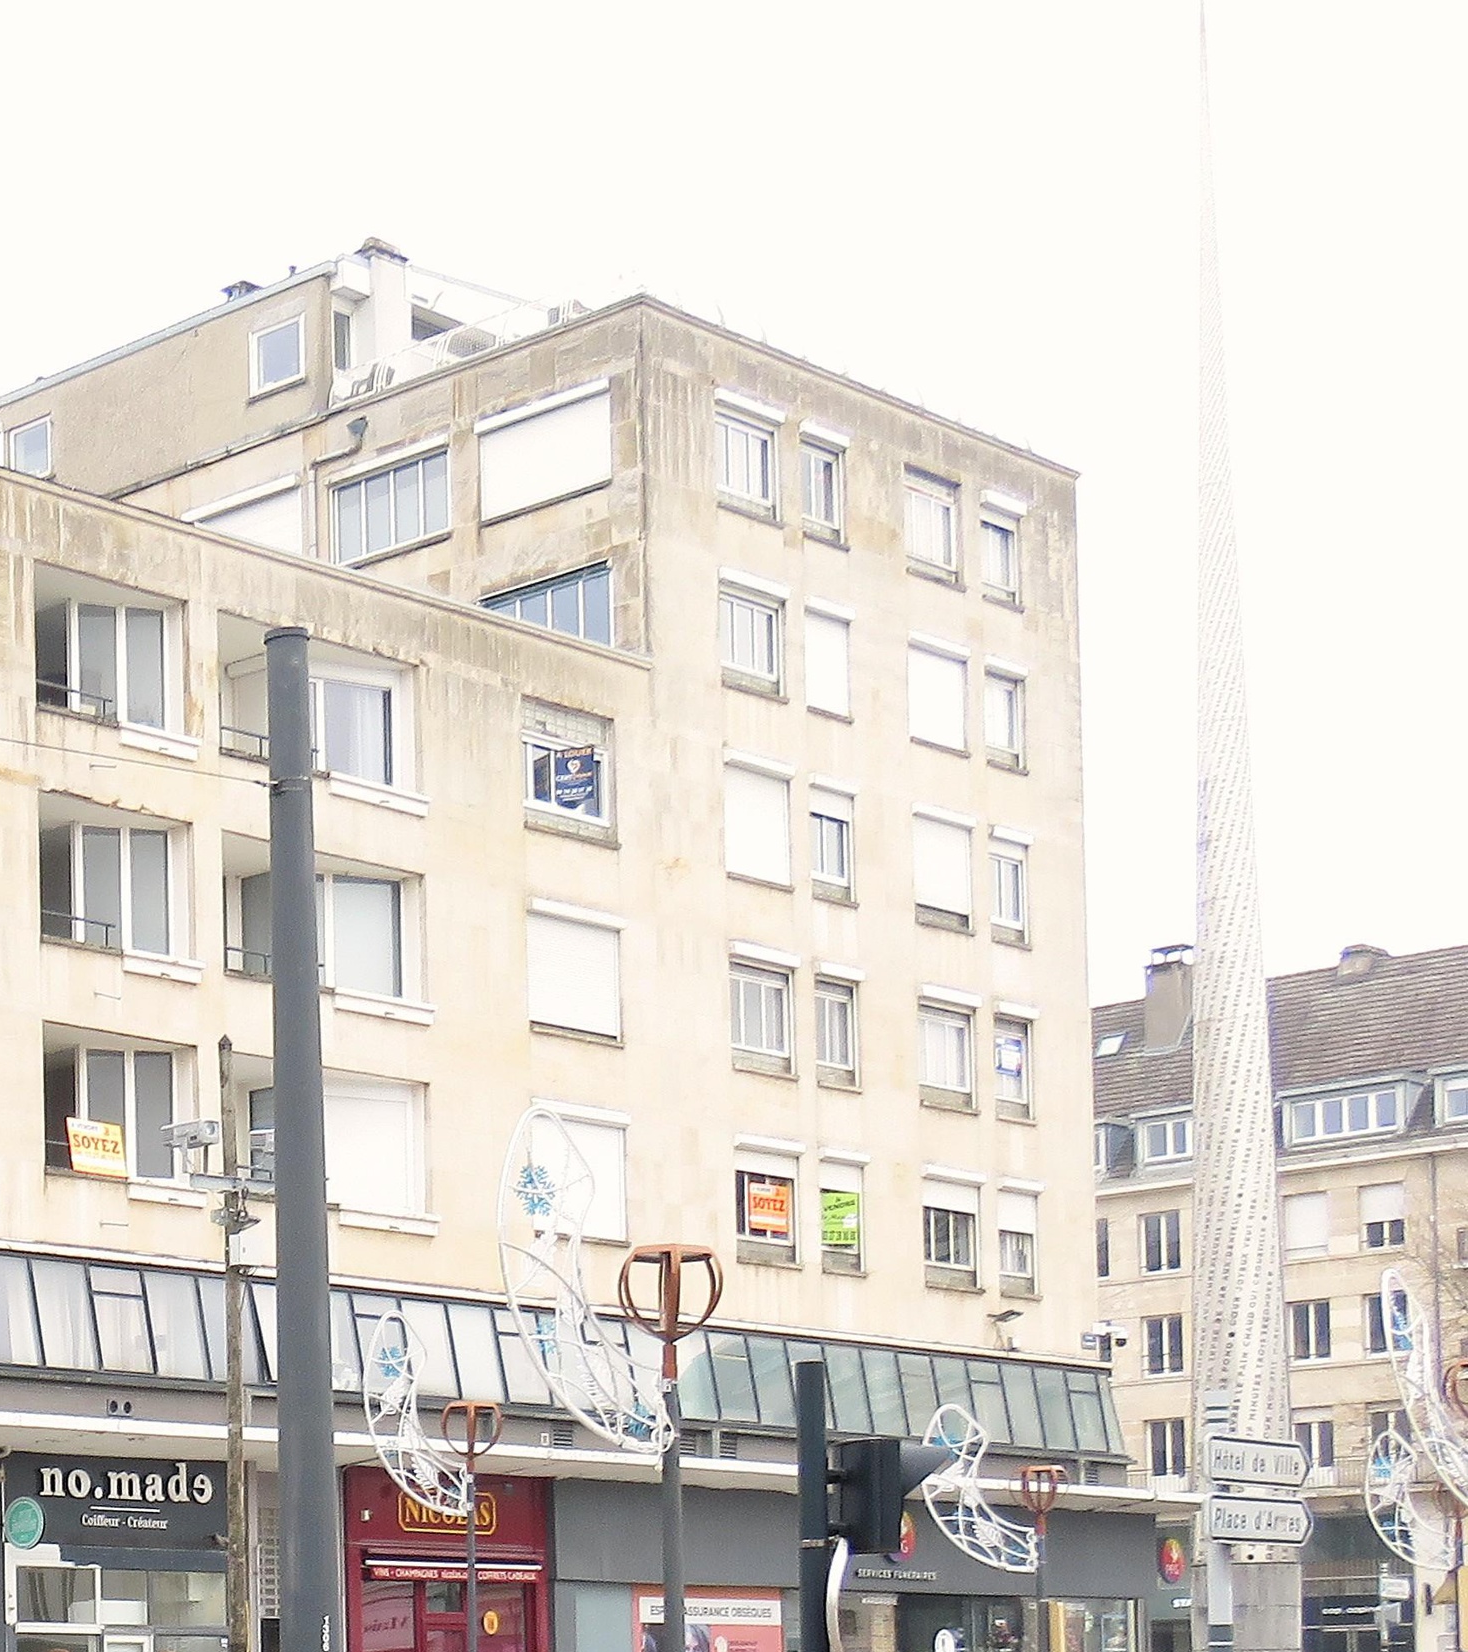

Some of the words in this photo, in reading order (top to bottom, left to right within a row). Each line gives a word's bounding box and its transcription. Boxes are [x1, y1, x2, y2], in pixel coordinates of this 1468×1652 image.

[73, 1133, 120, 1155] SOYEZ
[1213, 1449, 1245, 1473] Hôtel
[1252, 1457, 1266, 1473] de
[1273, 1455, 1300, 1476] Ville
[81, 1513, 120, 1528] Coiffeur
[127, 1515, 168, 1530] Créateur
[1213, 1507, 1247, 1531] Place
[857, 1567, 892, 1579] SERVICES
